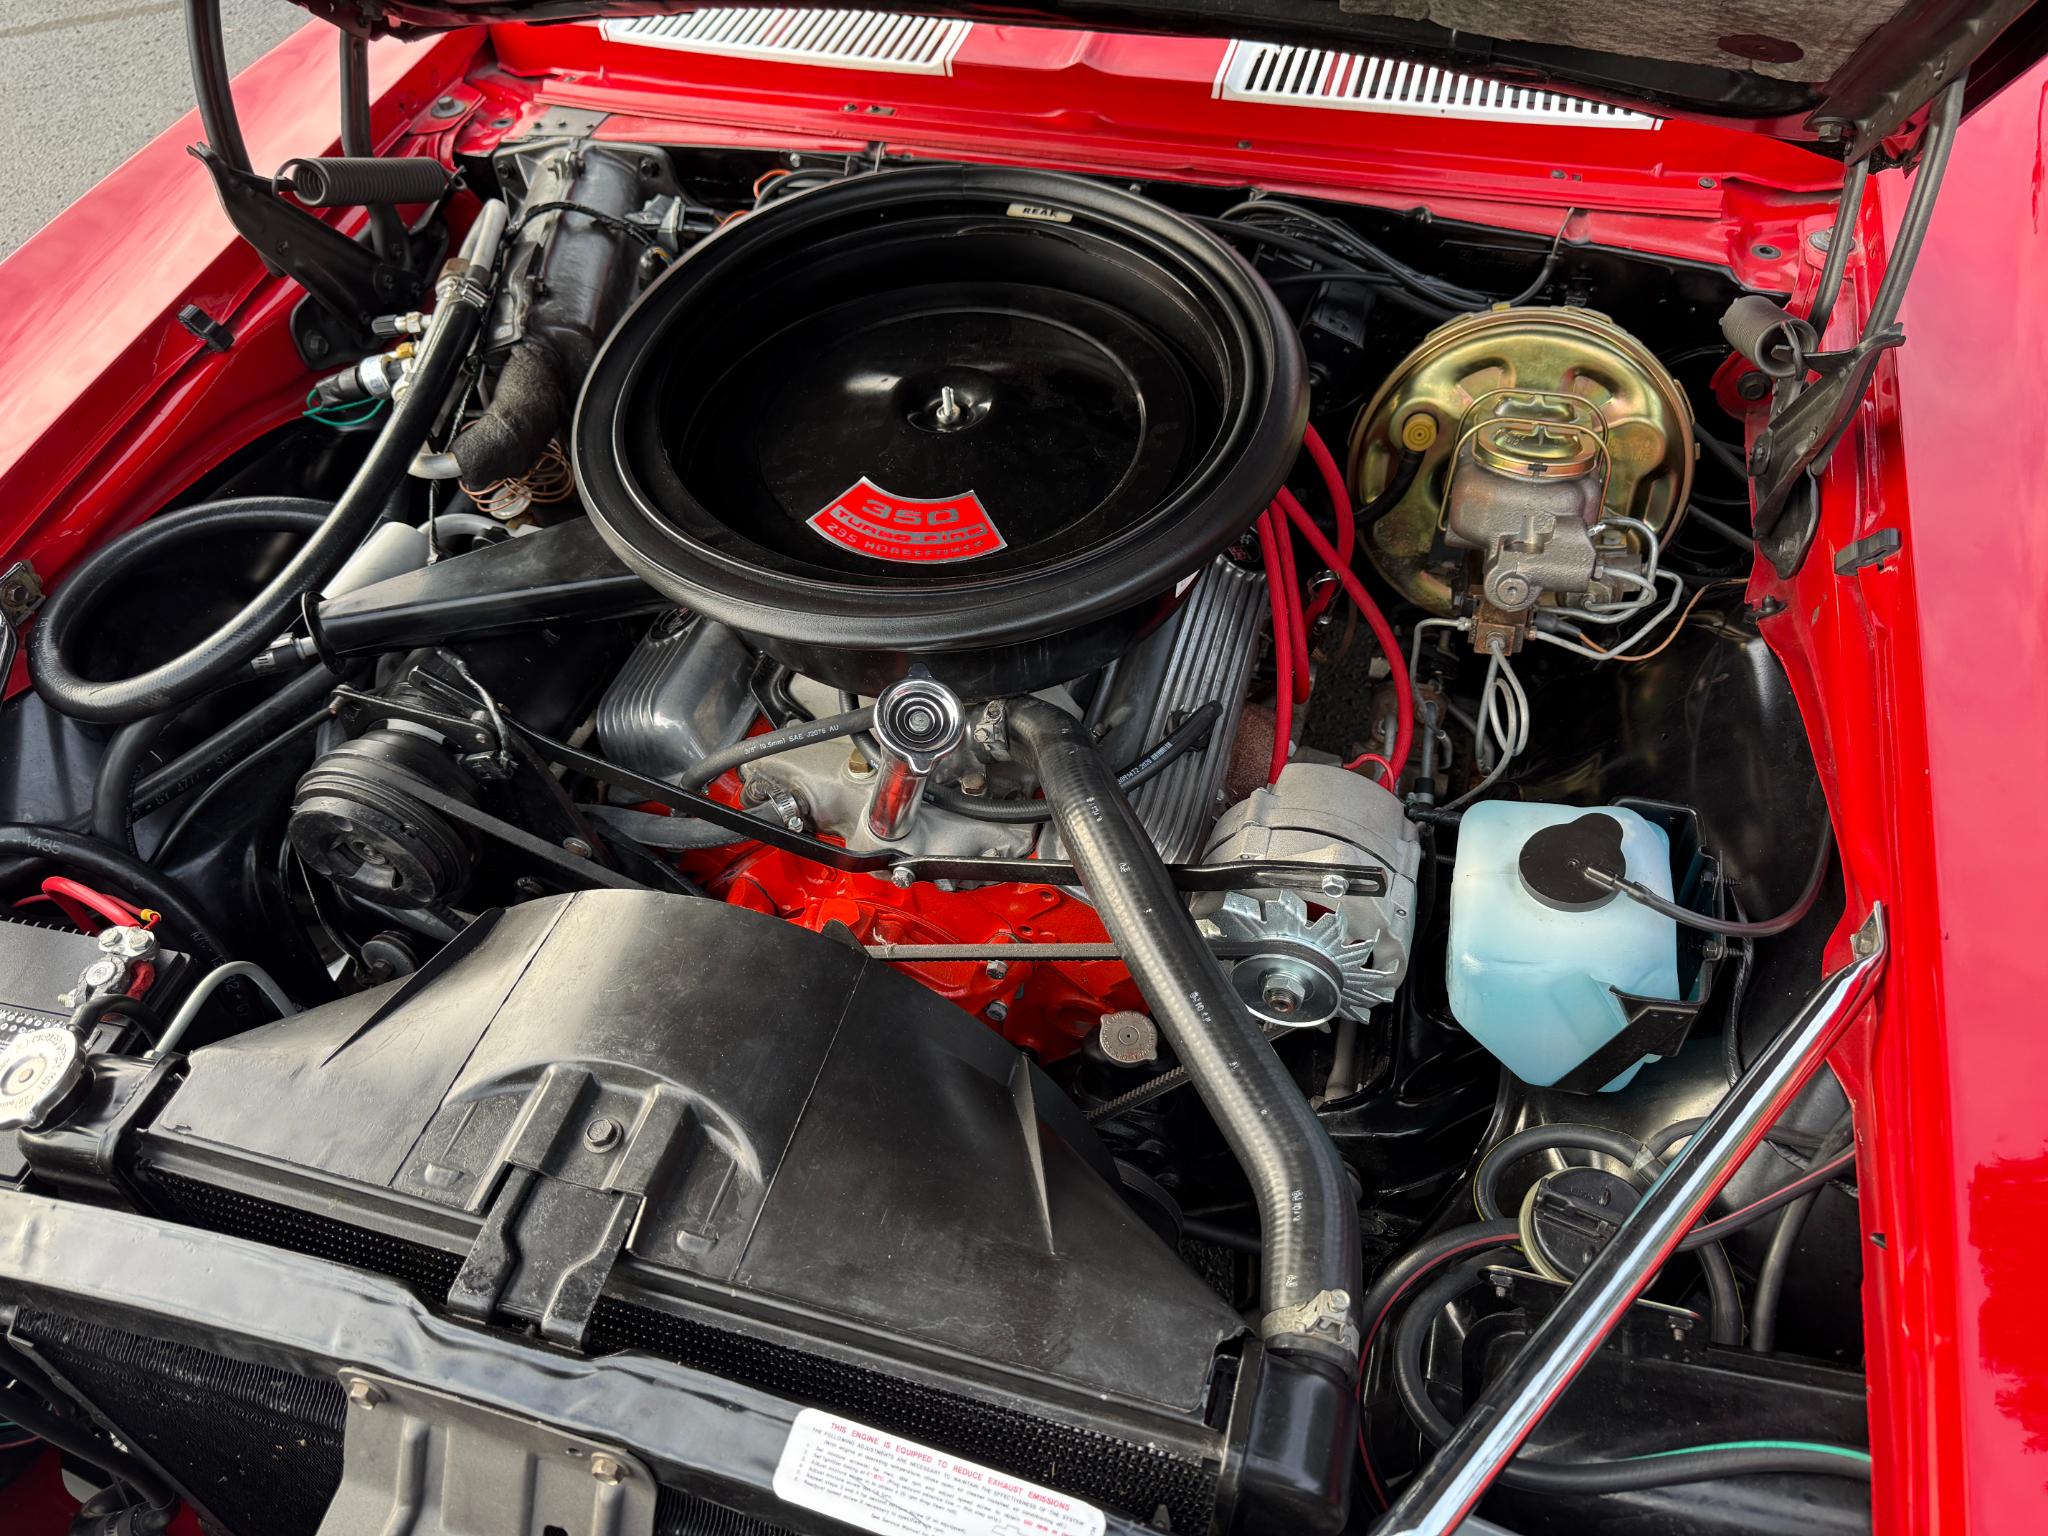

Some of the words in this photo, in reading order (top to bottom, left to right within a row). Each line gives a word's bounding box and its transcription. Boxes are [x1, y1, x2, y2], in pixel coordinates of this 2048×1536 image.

[861, 499, 960, 526] 350
[788, 732, 803, 743] SAE
[830, 1423, 847, 1434] THIS
[851, 1430, 879, 1445] ENGINE
[883, 1441, 891, 1449] IS
[894, 1445, 932, 1463] EQUIPPED
[936, 1459, 947, 1469] TO
[952, 1465, 982, 1481] REDUCE
[987, 1477, 1023, 1495] EXHAUST
[1027, 1491, 1071, 1511] EMISSIONS
